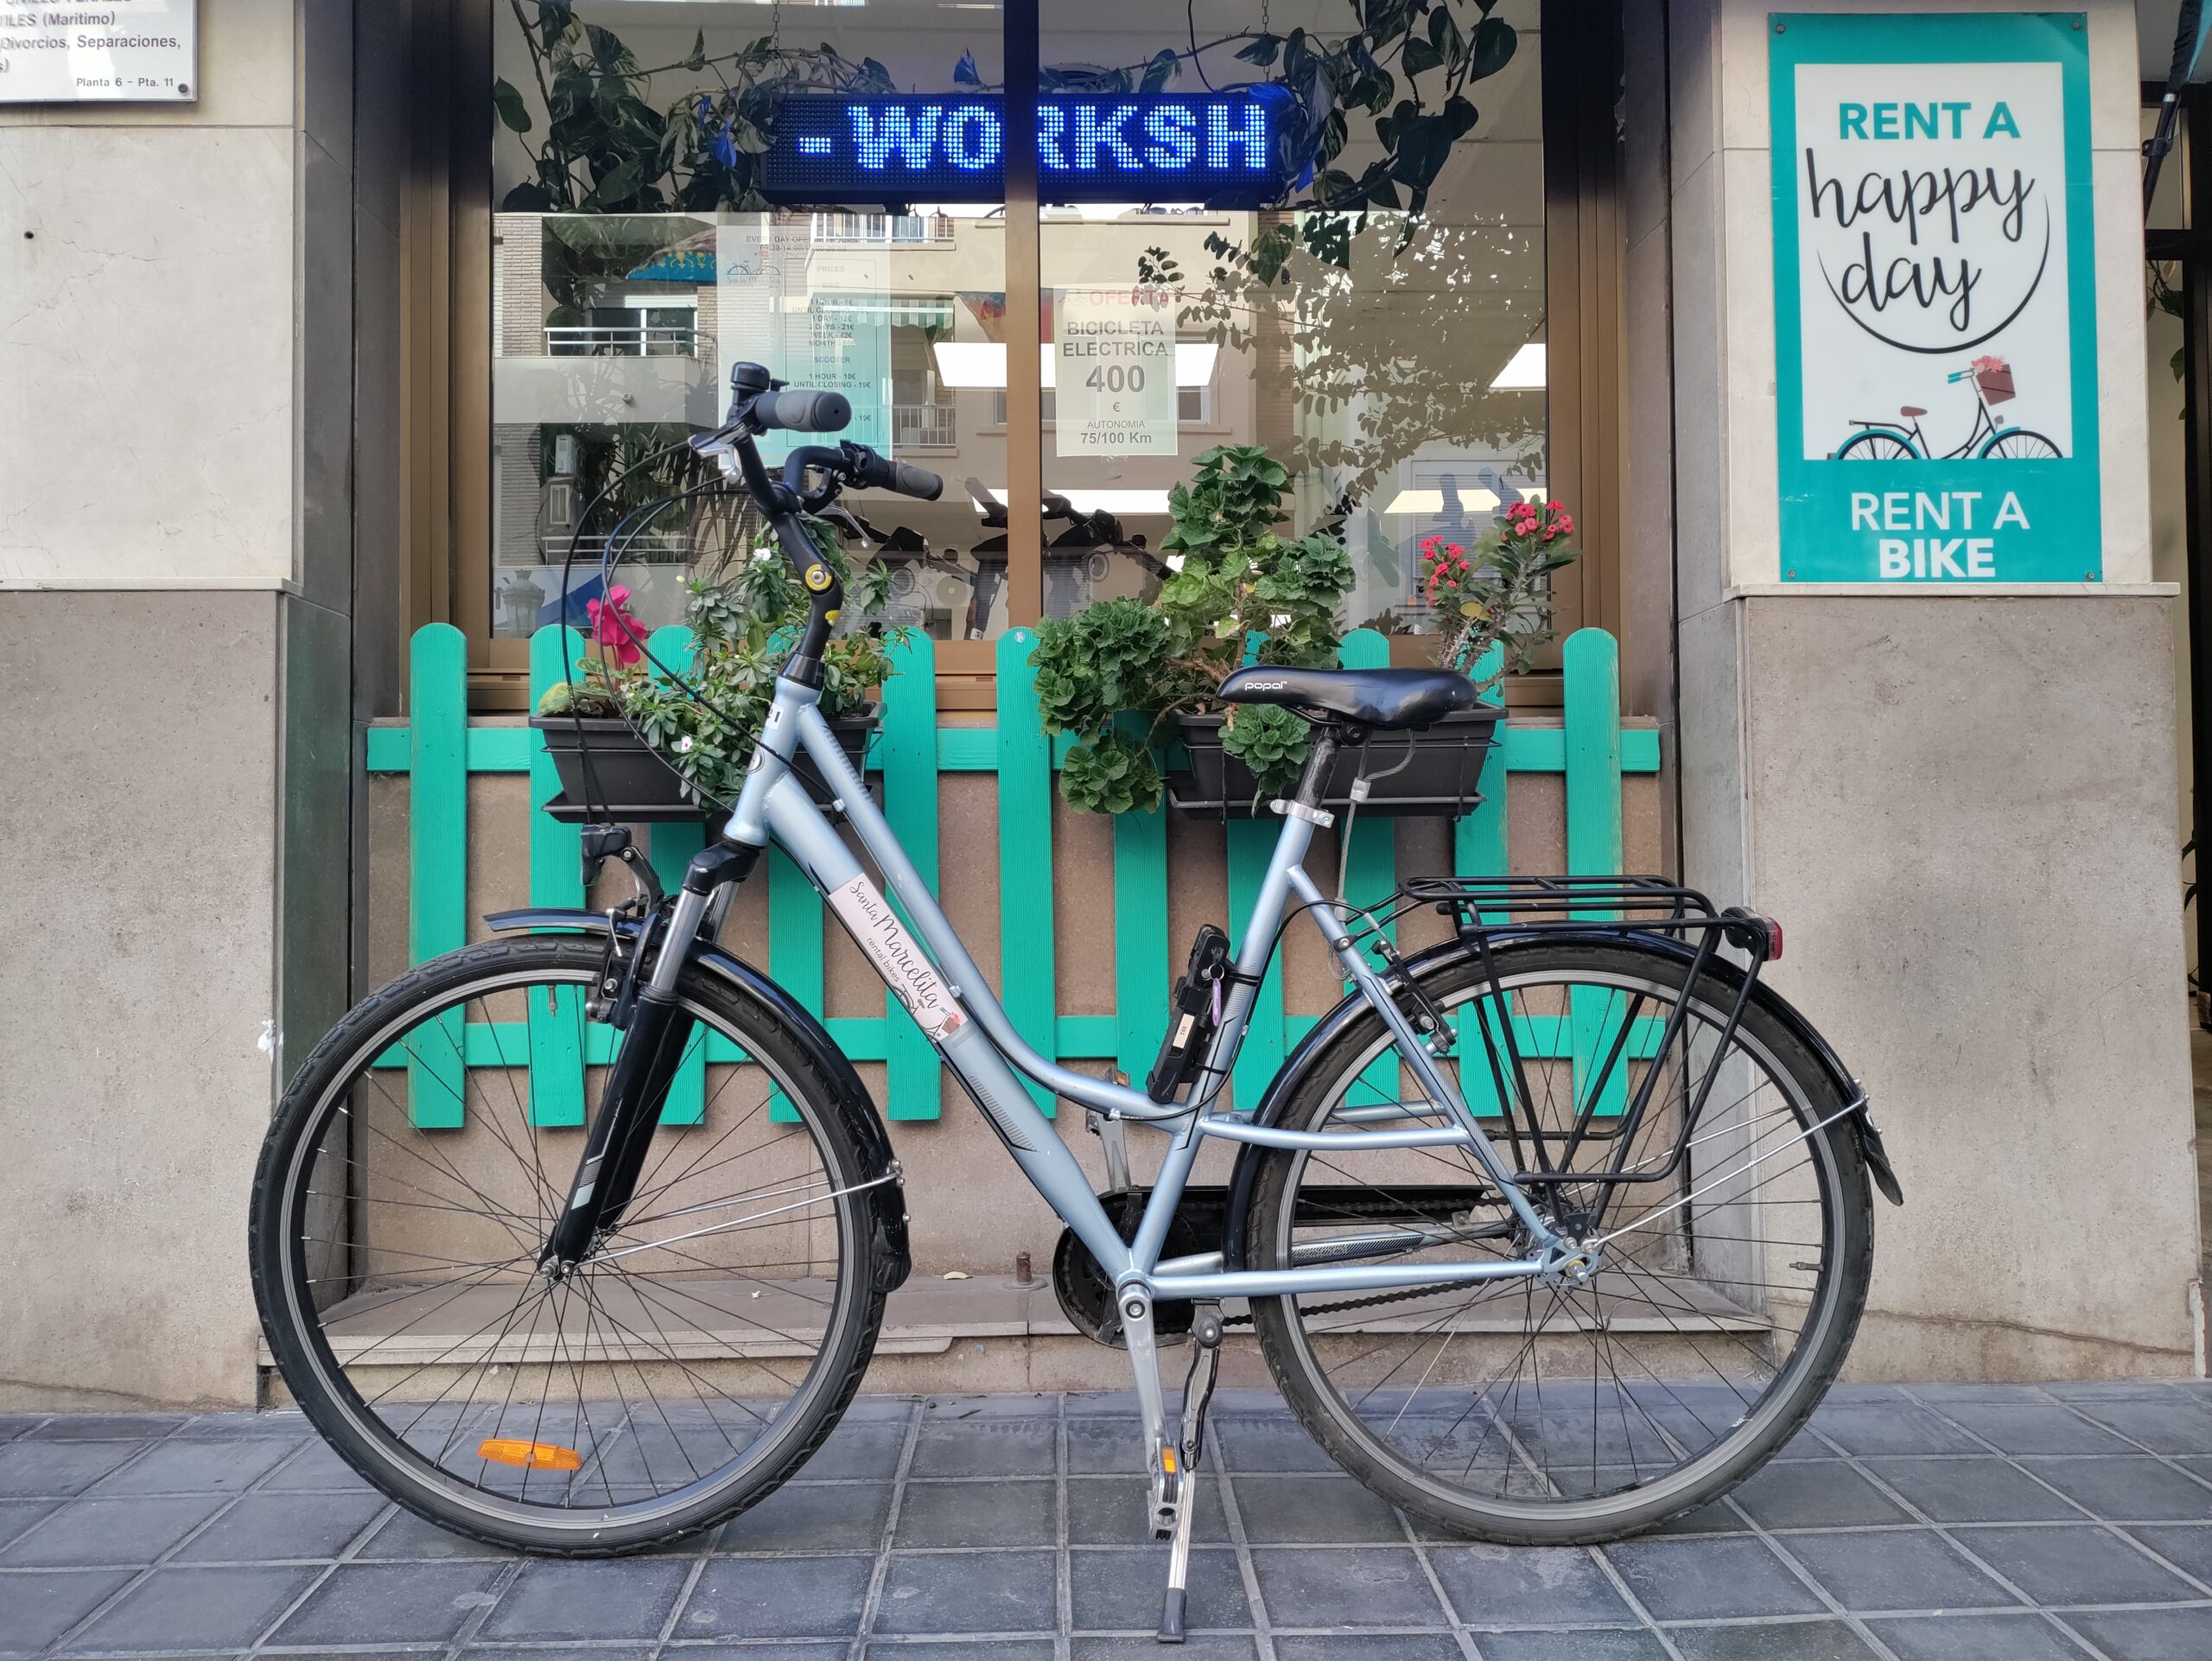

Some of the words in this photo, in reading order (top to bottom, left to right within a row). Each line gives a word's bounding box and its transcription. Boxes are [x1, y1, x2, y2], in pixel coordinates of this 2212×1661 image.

[77, 35, 181, 50] Separaciones,
[76, 78, 110, 87] Planta
[115, 78, 123, 87] 6
[138, 78, 160, 87] Pta.
[164, 78, 174, 87] 11
[1839, 102, 1972, 140] RENT
[1982, 101, 2021, 139] A
[1806, 147, 2036, 245] happy
[1841, 231, 1982, 332] day
[1067, 321, 1164, 335] BICICLETA
[1063, 341, 1168, 357] ELECTRICA
[1085, 365, 1145, 392] 400
[1112, 402, 1121, 412] €
[1081, 433, 1124, 444] 75/100
[1129, 432, 1152, 444] Km
[1087, 420, 1145, 429] AUTONOMIA
[1851, 491, 1982, 531] RENT
[1992, 490, 2031, 530] A
[1879, 538, 1996, 578] BIKE
[849, 881, 879, 921] Santa
[873, 914, 941, 1009] Marcelita
[866, 938, 886, 963] rental
[884, 960, 900, 983] bikes
